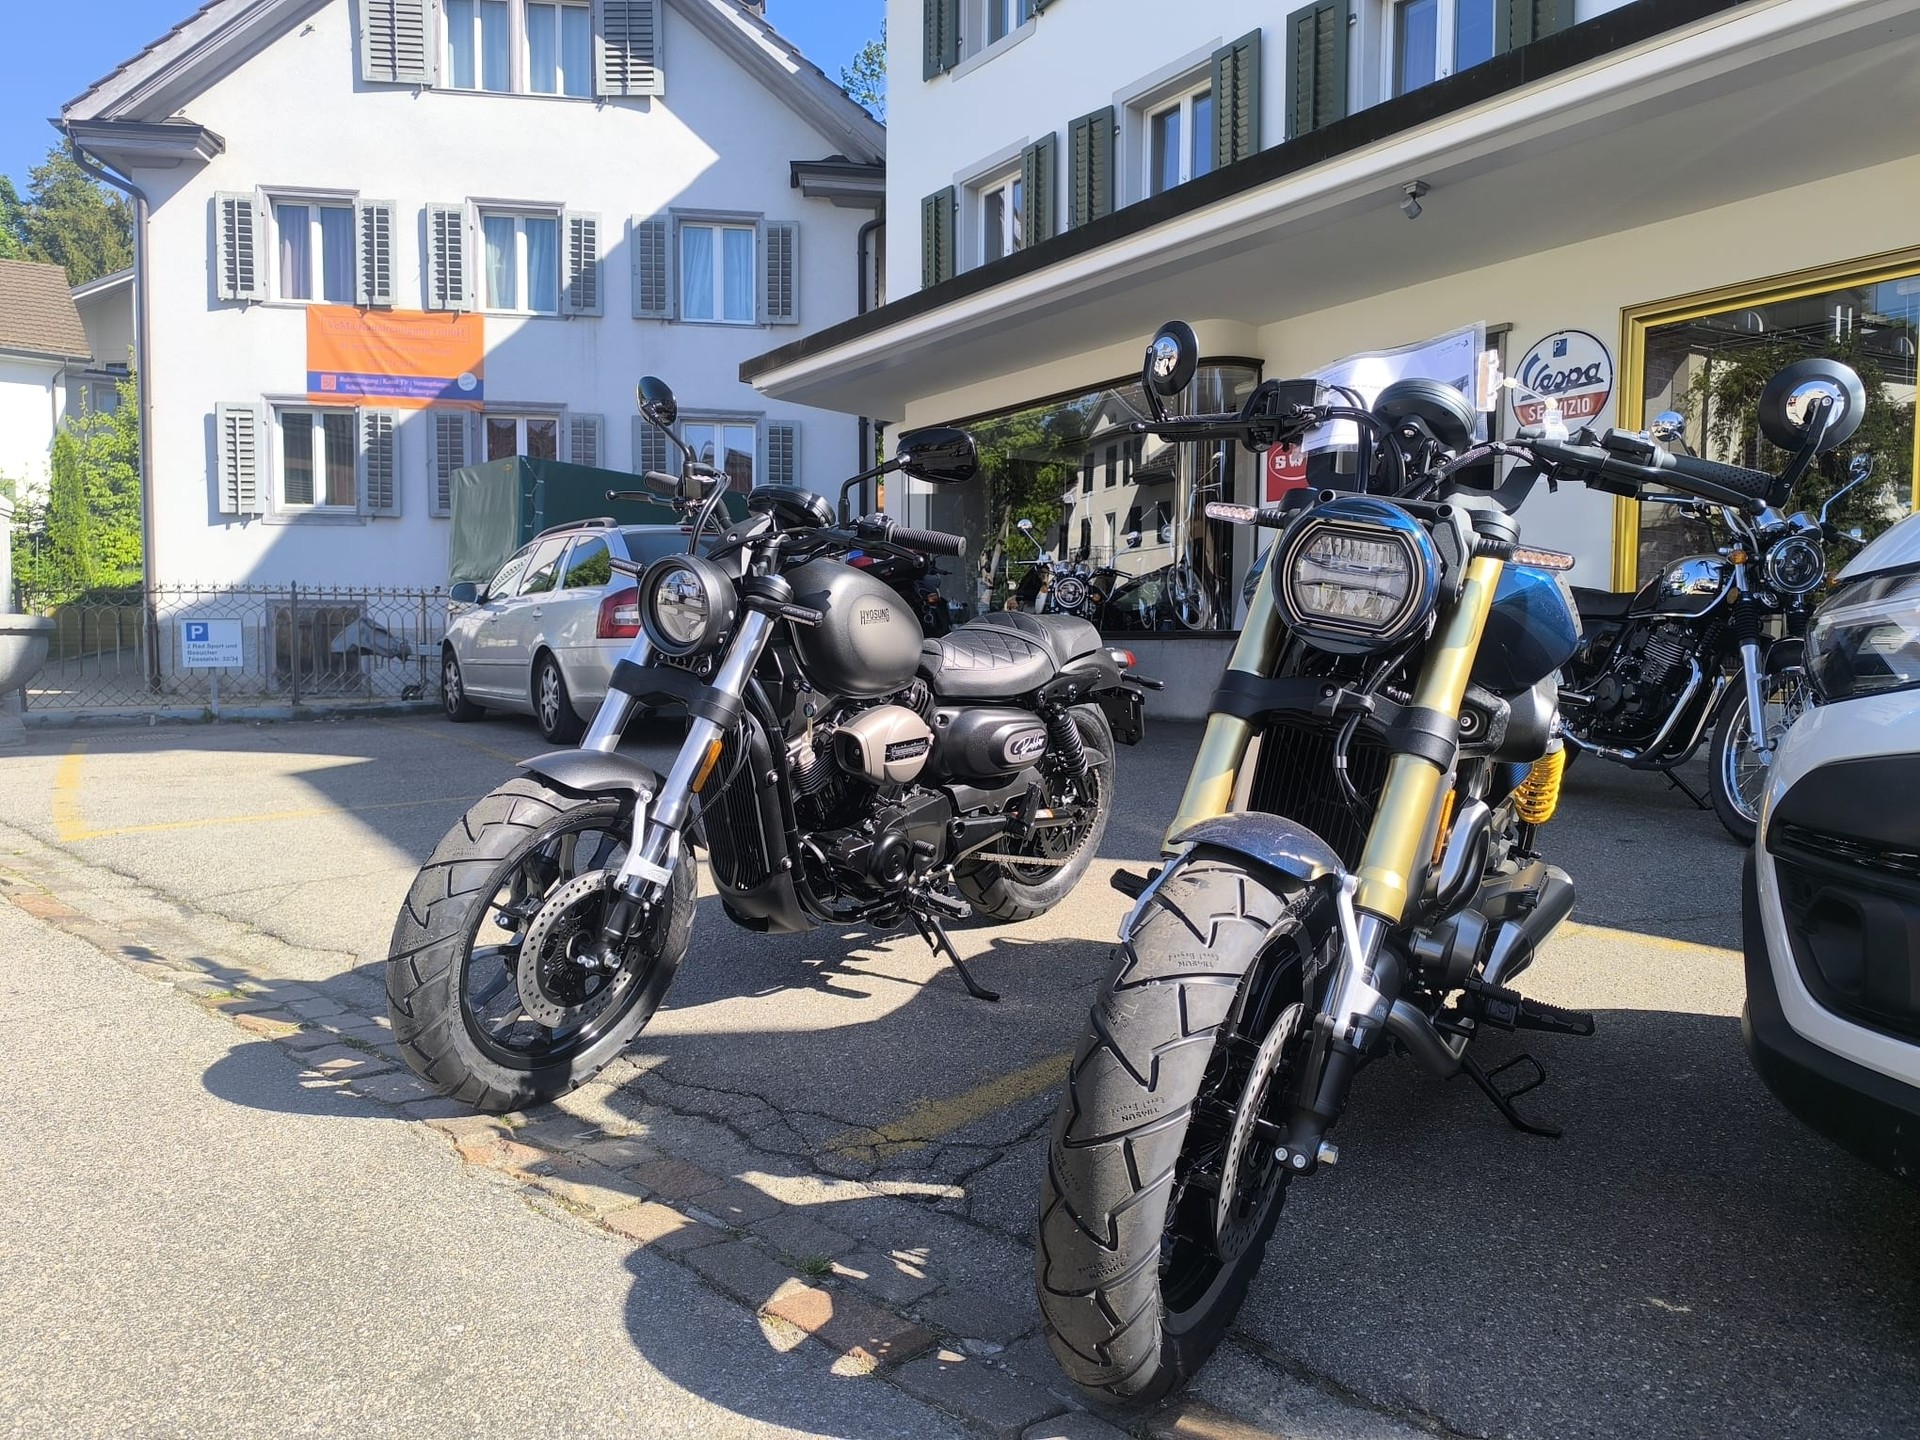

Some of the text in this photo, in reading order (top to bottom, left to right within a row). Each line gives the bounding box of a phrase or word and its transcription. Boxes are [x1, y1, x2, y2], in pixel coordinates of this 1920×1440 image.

[1522, 354, 1604, 397] Vespa
[1528, 397, 1590, 421] SEIZIO
[860, 608, 890, 625] HYOSUNG
[191, 625, 204, 640] P
